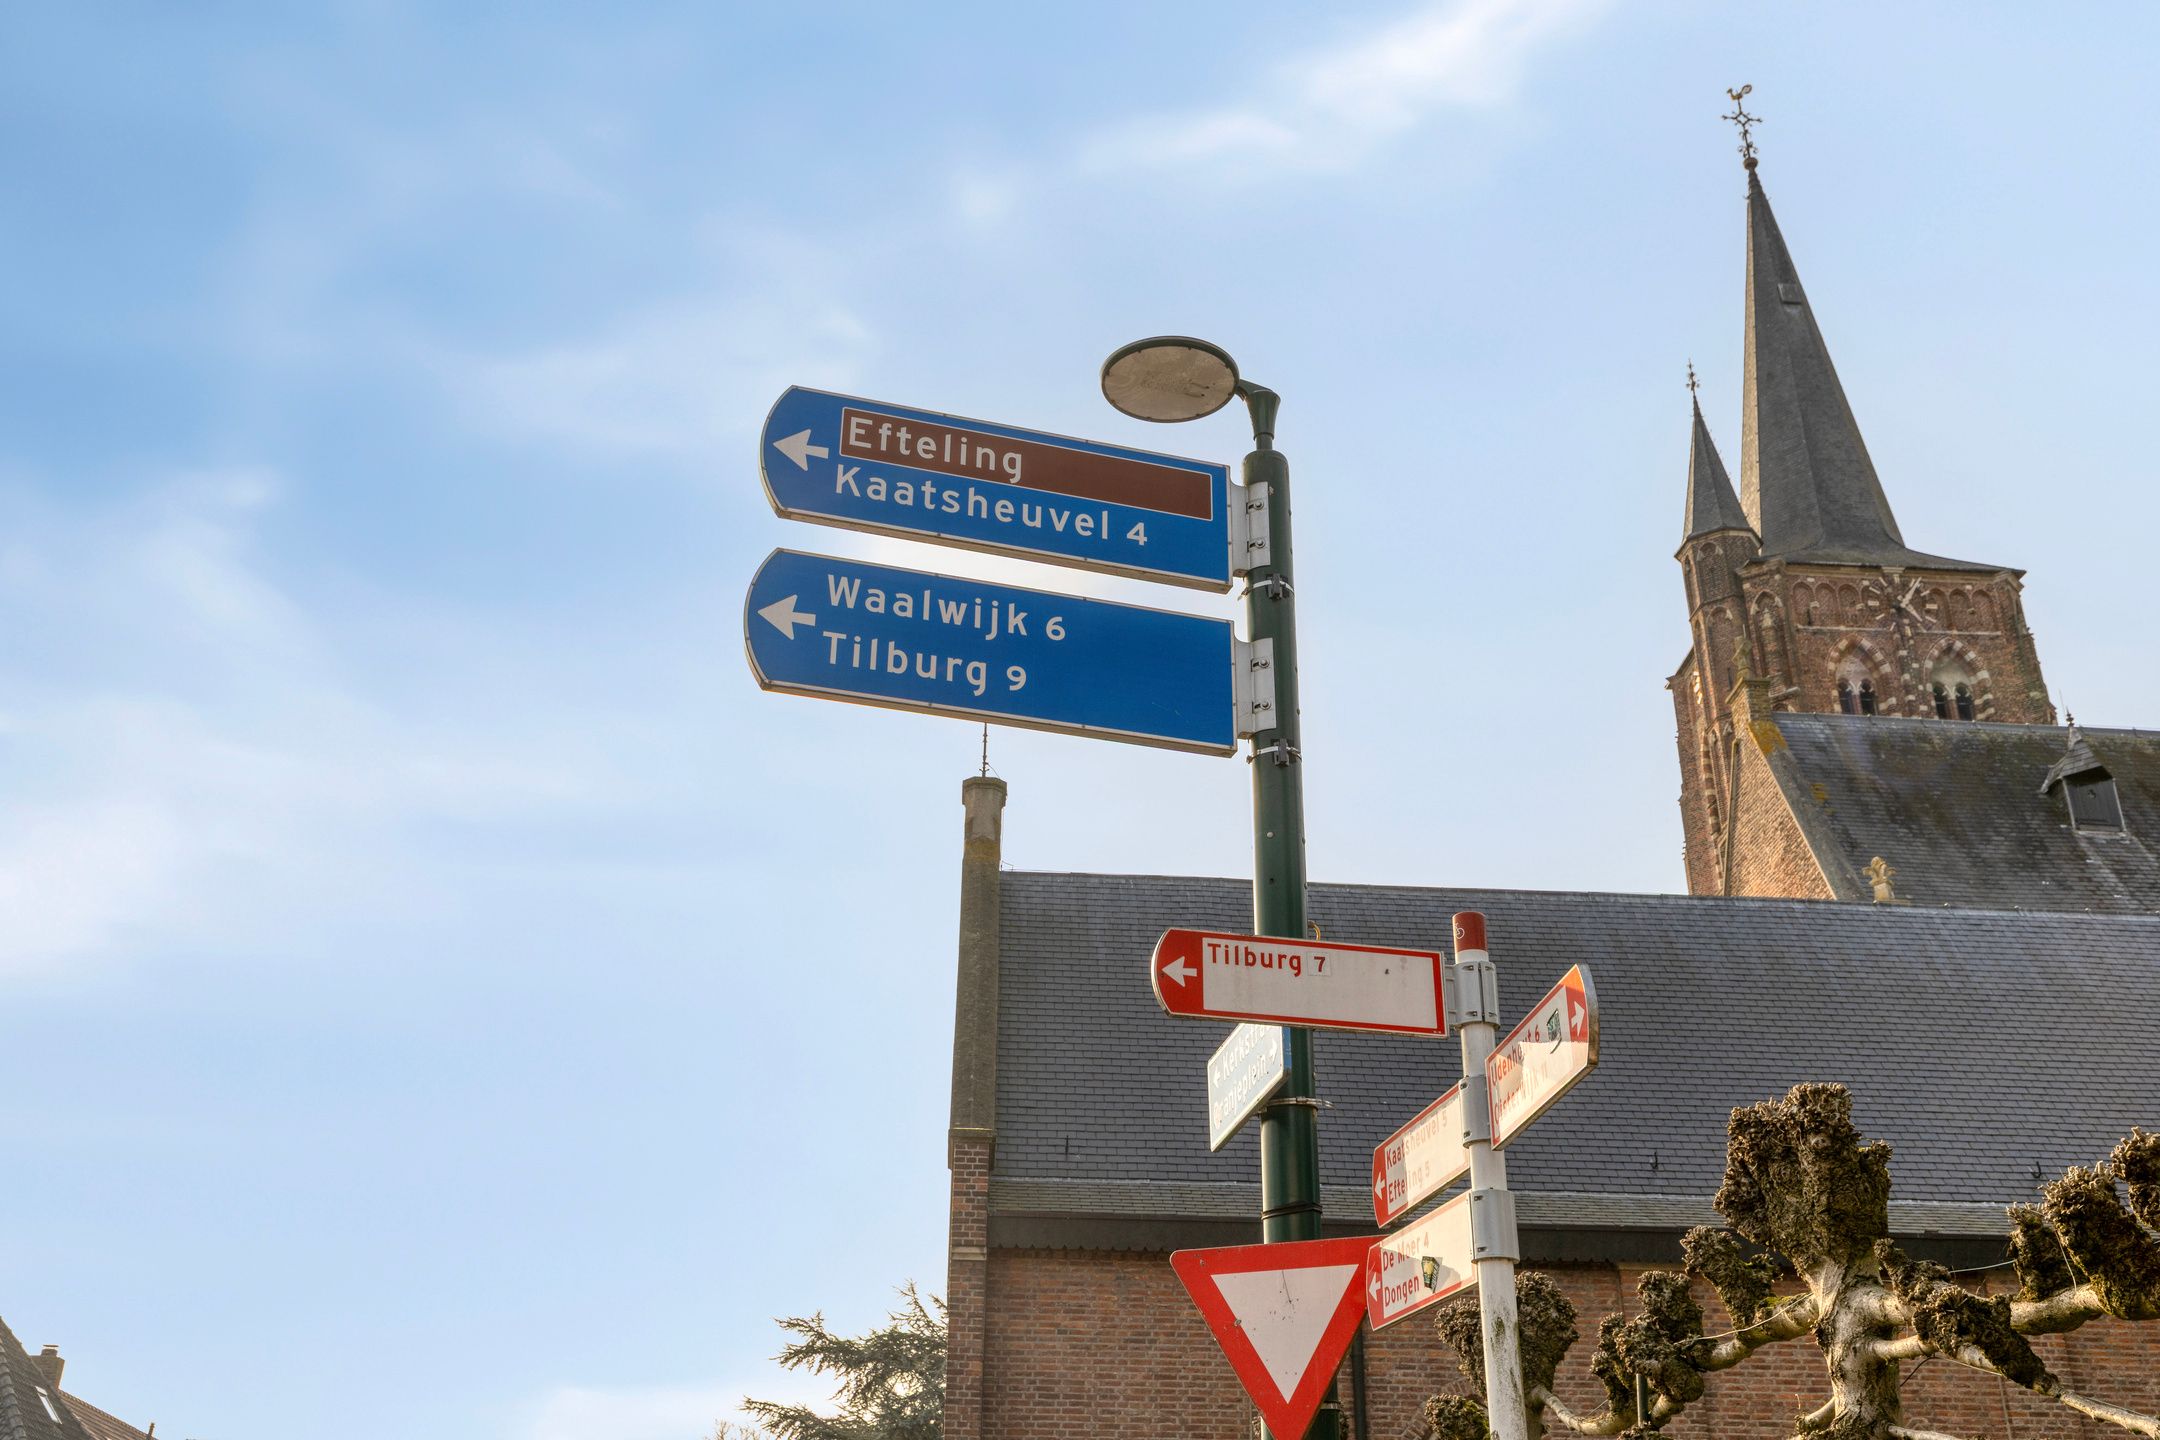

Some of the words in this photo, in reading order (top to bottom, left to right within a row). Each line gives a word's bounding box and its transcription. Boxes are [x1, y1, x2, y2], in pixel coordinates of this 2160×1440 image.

[848, 416, 1023, 484] Efteling
[834, 463, 1109, 540] Kaatsheuvel
[1126, 522, 1148, 546] 4
[827, 573, 1028, 641] Waalwijk
[1045, 616, 1066, 641] 6
[822, 631, 987, 696] Tilburg
[1006, 665, 1027, 691] 9
[1207, 942, 1302, 977] Tilburg
[1313, 955, 1326, 973] 7
[1534, 1024, 1540, 1043] 6
[1386, 1112, 1440, 1170] Kaatsheuvel
[1442, 1110, 1448, 1128] 5
[1388, 1165, 1423, 1204] Efteling
[1425, 1160, 1431, 1178] 5
[1382, 1250, 1394, 1272] De
[1397, 1237, 1420, 1262] Moer
[1423, 1231, 1429, 1249] 4
[1384, 1275, 1420, 1308] Dongen
